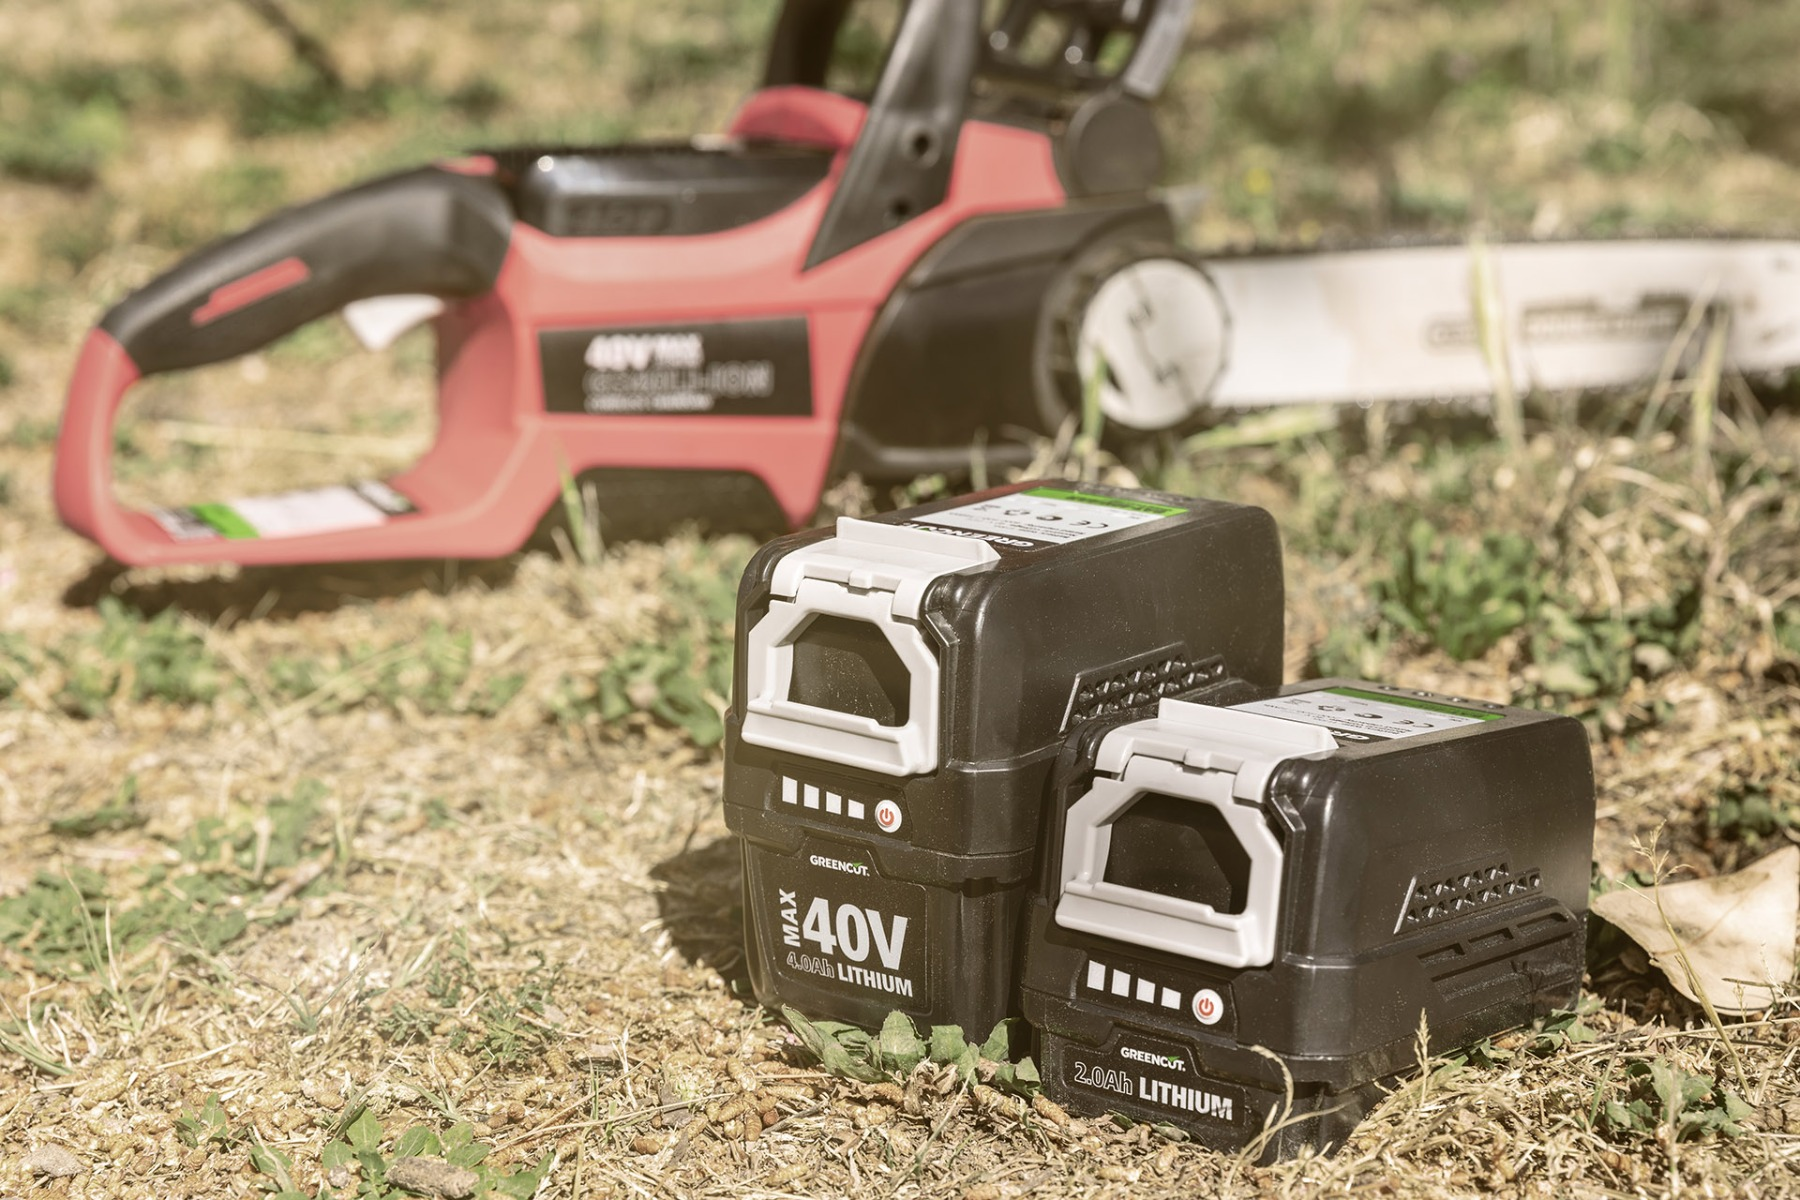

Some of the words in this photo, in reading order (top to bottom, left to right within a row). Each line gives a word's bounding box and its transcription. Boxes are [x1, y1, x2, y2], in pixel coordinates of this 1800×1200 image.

[779, 888, 801, 948] MAX
[802, 897, 908, 970] 40V
[786, 951, 835, 979] 4.0Ah
[837, 962, 913, 998] LITHIUM
[1074, 1061, 1133, 1096] 2.0Ah
[1139, 1076, 1233, 1121] LITHIUM
